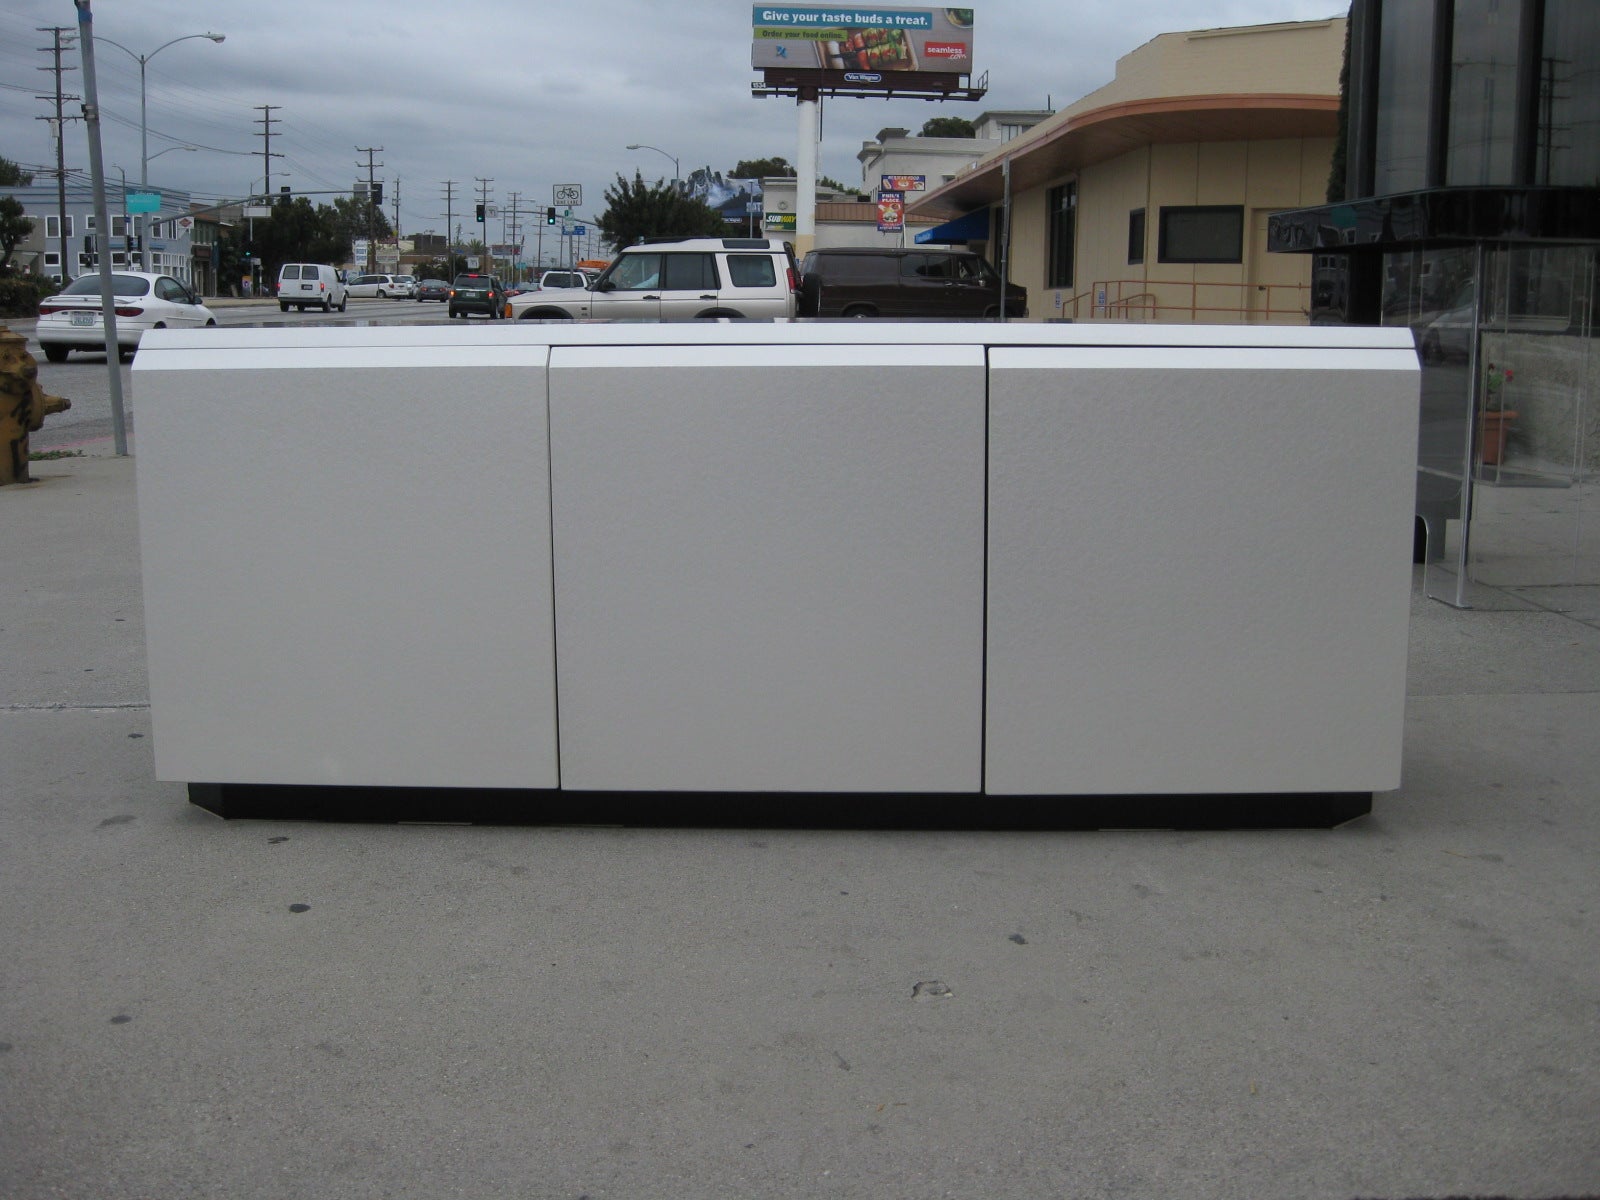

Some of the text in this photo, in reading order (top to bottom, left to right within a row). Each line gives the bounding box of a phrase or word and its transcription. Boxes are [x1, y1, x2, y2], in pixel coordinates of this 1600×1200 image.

[762, 10, 928, 26] Give your taste buds a treat.
[762, 30, 782, 38] Order
[785, 31, 800, 39] your
[820, 31, 844, 39] online.
[927, 46, 963, 54] seamless
[766, 215, 797, 223] SUBWAY
